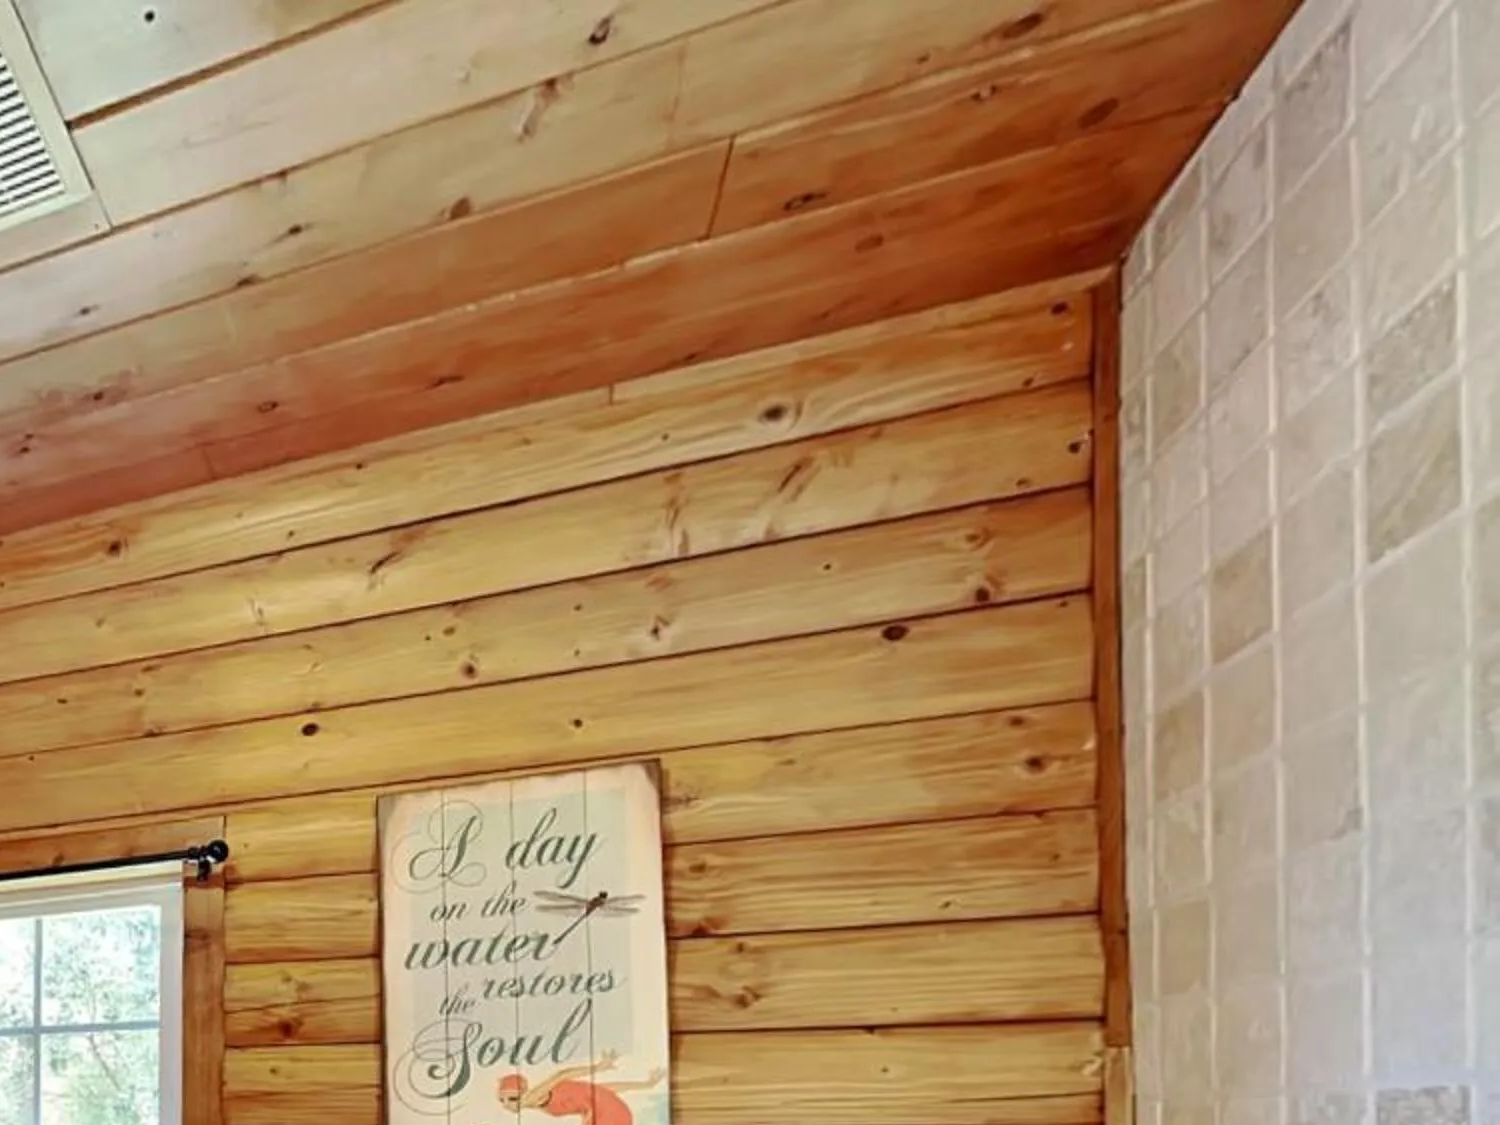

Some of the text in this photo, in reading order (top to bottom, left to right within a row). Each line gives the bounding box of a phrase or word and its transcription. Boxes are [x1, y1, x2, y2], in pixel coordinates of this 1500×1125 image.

[396, 801, 598, 888] A day
[430, 878, 527, 922] on the
[404, 925, 557, 972] water
[438, 985, 480, 1016] the
[482, 968, 618, 1000] restores
[392, 998, 593, 1103] Soul
